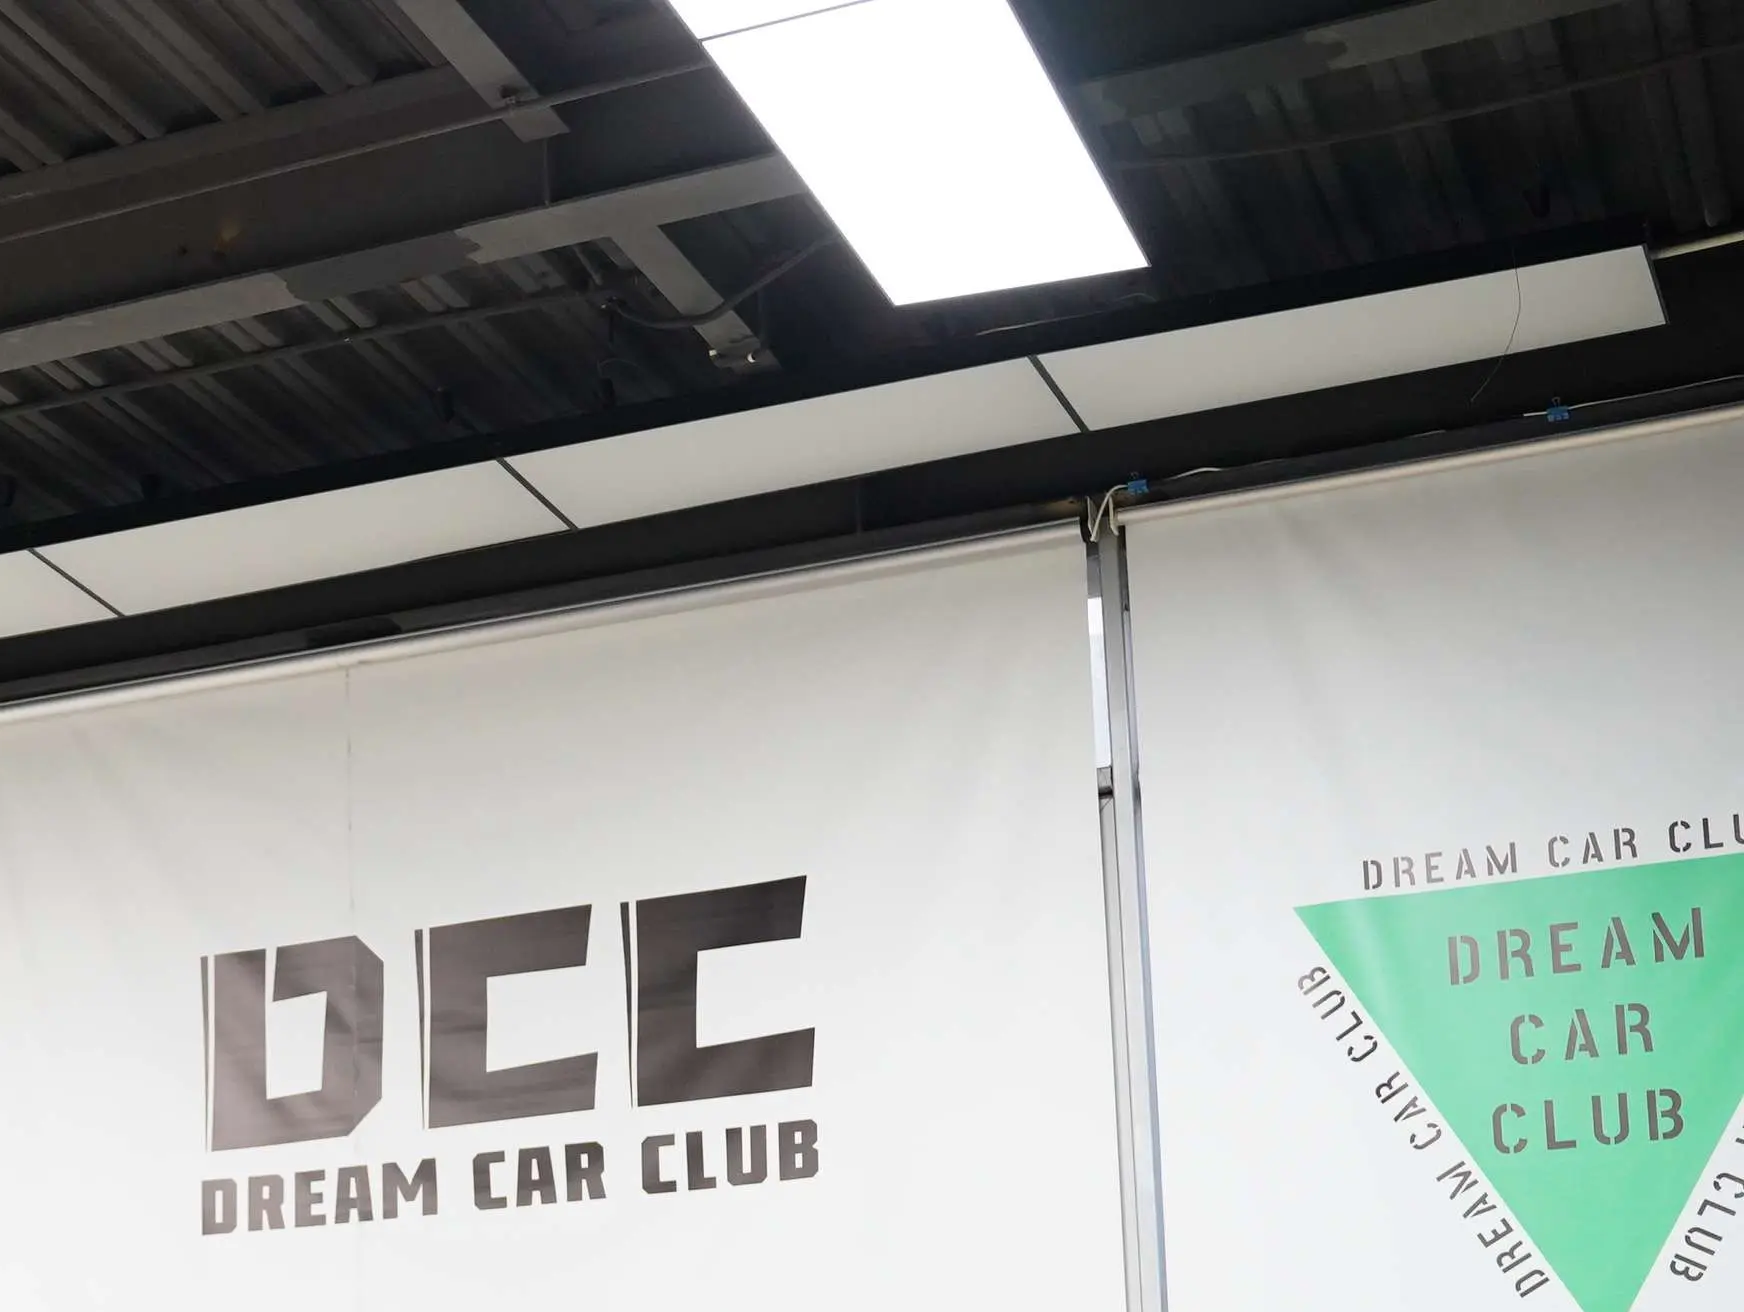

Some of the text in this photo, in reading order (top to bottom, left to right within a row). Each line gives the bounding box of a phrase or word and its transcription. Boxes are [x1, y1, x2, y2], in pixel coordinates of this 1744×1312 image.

[1363, 842, 1517, 890] DREAM
[1548, 828, 1637, 867] CAR
[1449, 907, 1704, 985] DREAM
[200, 875, 818, 1153] DCC
[1511, 1003, 1653, 1064] CAR
[1299, 967, 1549, 1298] DREAM CAR CLUB
[1493, 1089, 1683, 1153] CLUB
[202, 1119, 818, 1235] DREAM CAR CLUB
[1670, 1173, 1744, 1281] CLUB
